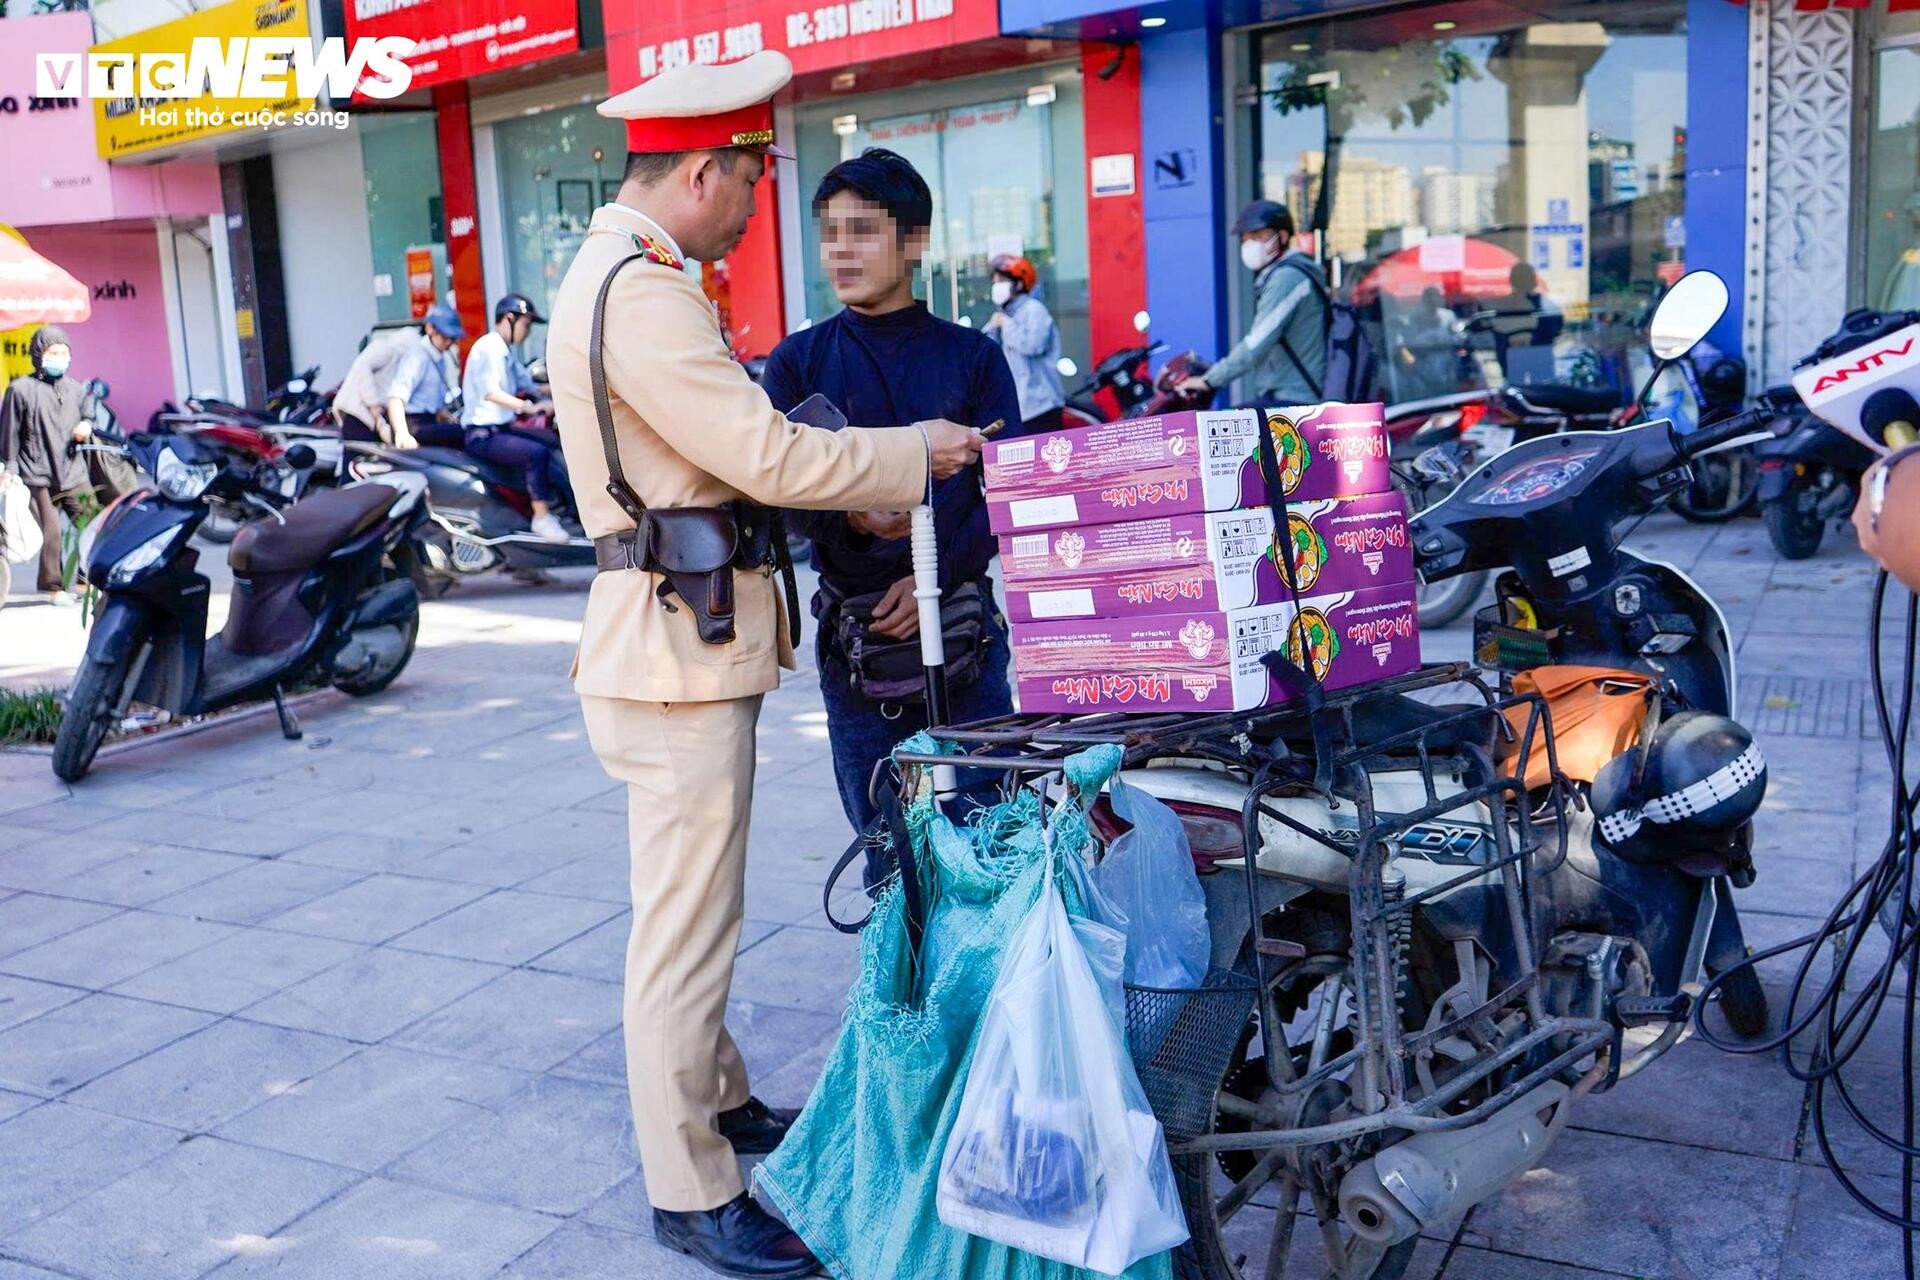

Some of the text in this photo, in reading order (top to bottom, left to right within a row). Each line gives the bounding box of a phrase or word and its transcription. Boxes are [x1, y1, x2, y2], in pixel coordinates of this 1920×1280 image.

[94, 280, 136, 301] xinh
[1813, 337, 1914, 395] ANTV
[1101, 479, 1188, 508] Mì Gà Nấm
[1335, 524, 1404, 554] Mì Gà Nấm
[1118, 578, 1203, 604] Mì Gà Nấm
[1348, 614, 1412, 646] Mì Gà Nấm
[1052, 672, 1171, 705] Mì Gà Nấm
